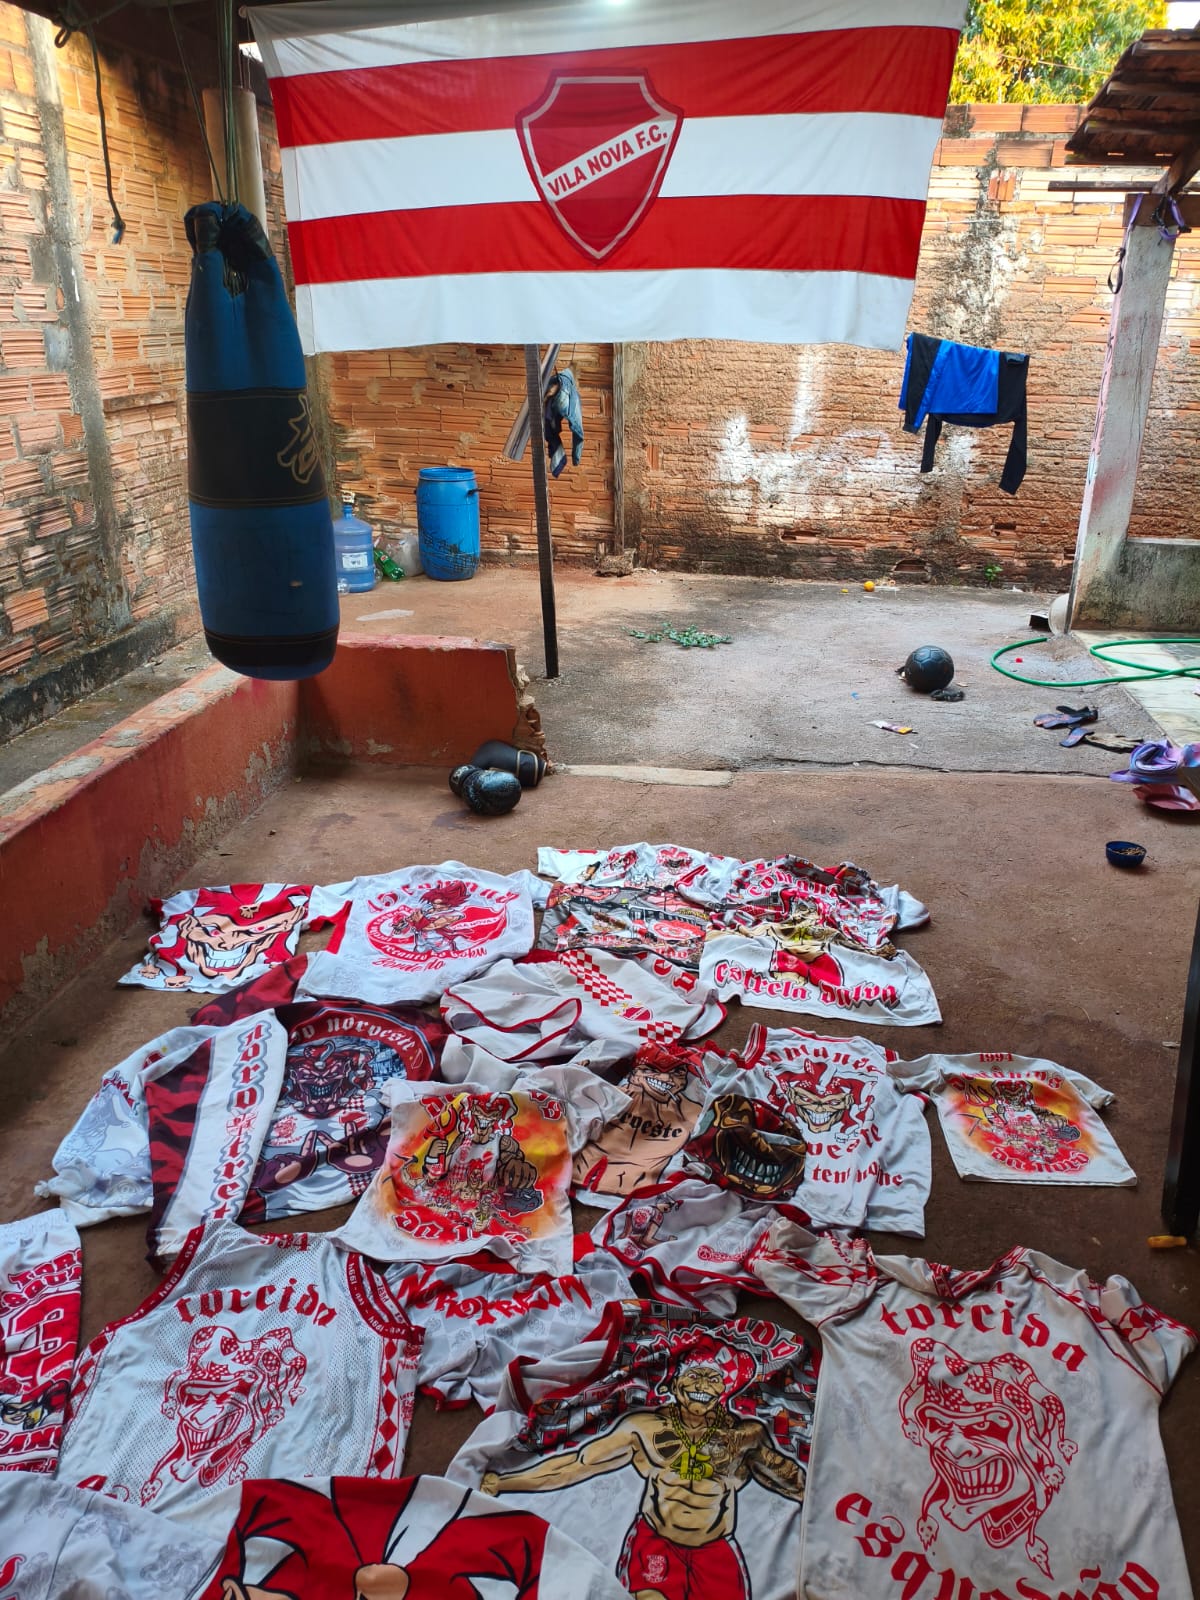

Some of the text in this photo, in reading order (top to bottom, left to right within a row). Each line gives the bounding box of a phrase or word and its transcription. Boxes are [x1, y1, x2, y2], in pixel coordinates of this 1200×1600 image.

[547, 124, 668, 197] VILA NOVA F.C.
[879, 1300, 1089, 1373] torcida
[834, 1493, 1161, 1600] esquão
